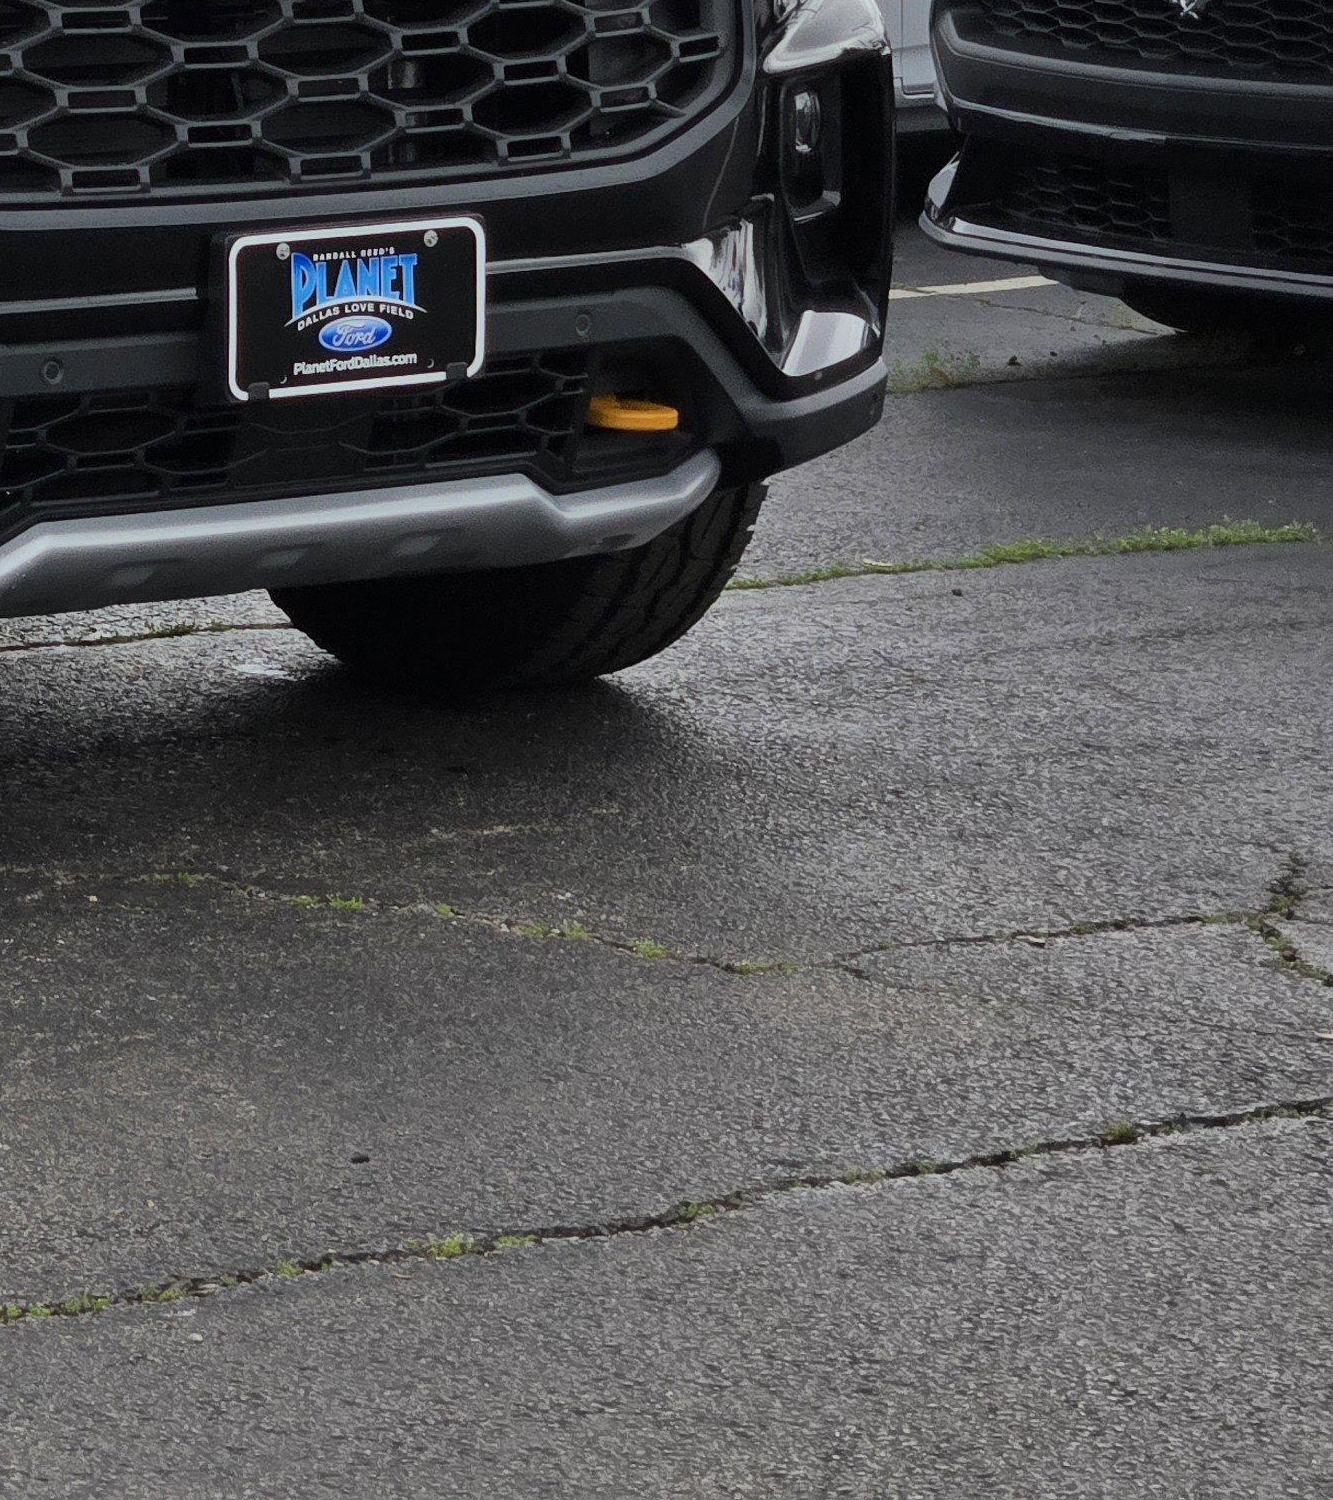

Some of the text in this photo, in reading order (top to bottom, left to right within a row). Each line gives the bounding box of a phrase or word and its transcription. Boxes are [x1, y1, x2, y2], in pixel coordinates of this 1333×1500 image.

[291, 252, 418, 322] PLANET
[297, 302, 414, 332] DALLAS LOVE FIELD
[332, 320, 377, 348] Ford
[293, 352, 418, 376] PlanetFordDallas.com
